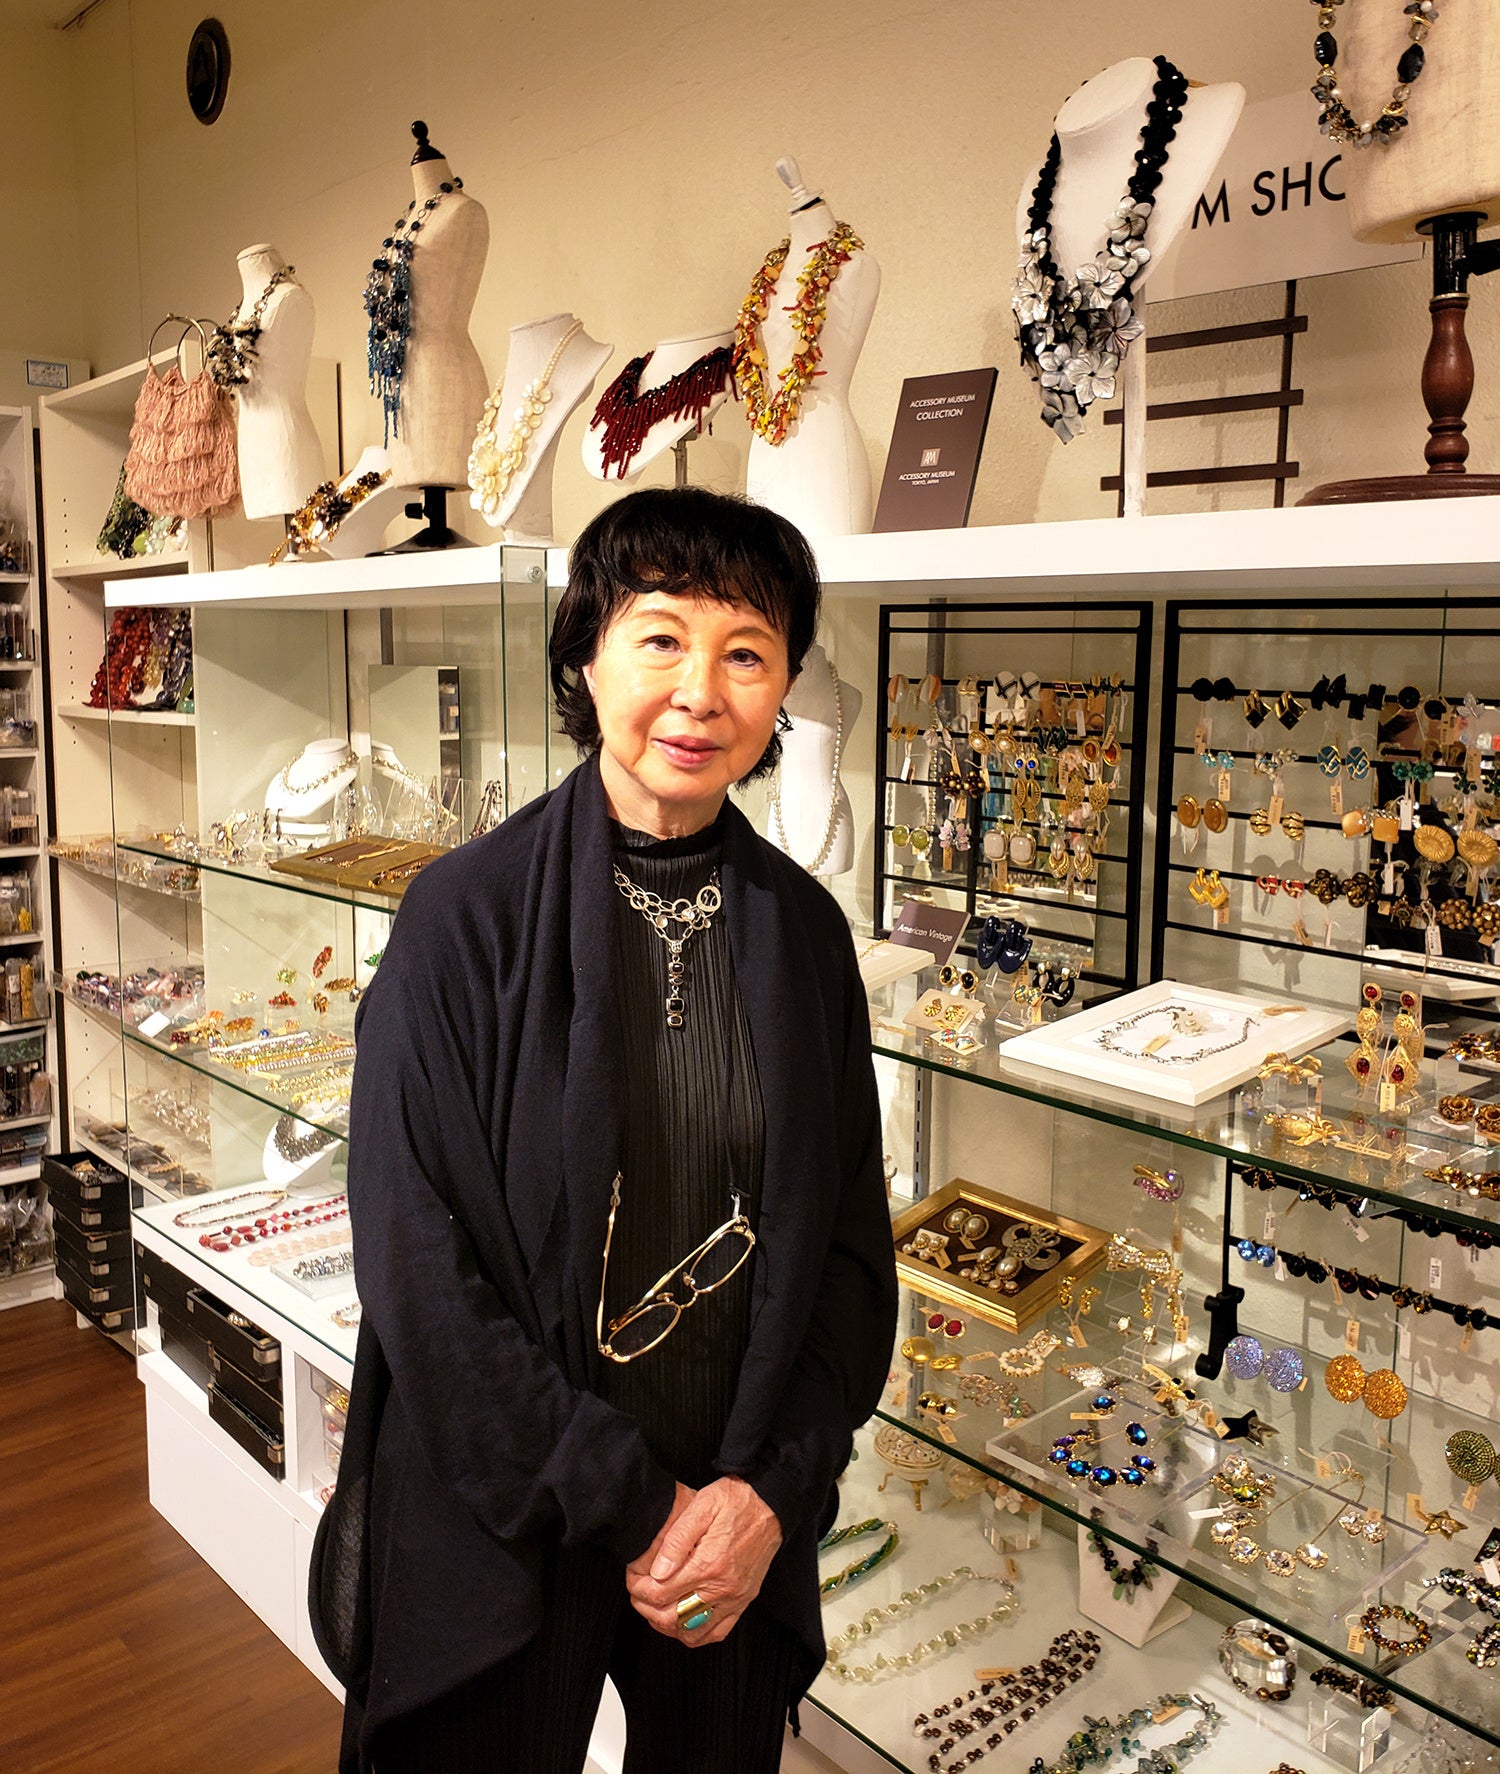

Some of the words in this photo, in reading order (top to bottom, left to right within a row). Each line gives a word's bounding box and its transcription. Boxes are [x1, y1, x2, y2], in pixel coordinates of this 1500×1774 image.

[909, 397, 947, 408] ACCESSORY
[947, 394, 976, 404] MUSEUM
[916, 408, 963, 421] COLLECTION
[898, 472, 931, 481] ACCESSORY
[930, 470, 956, 478] MUSEUM
[897, 923, 928, 937] American
[929, 928, 953, 943] Vintage
